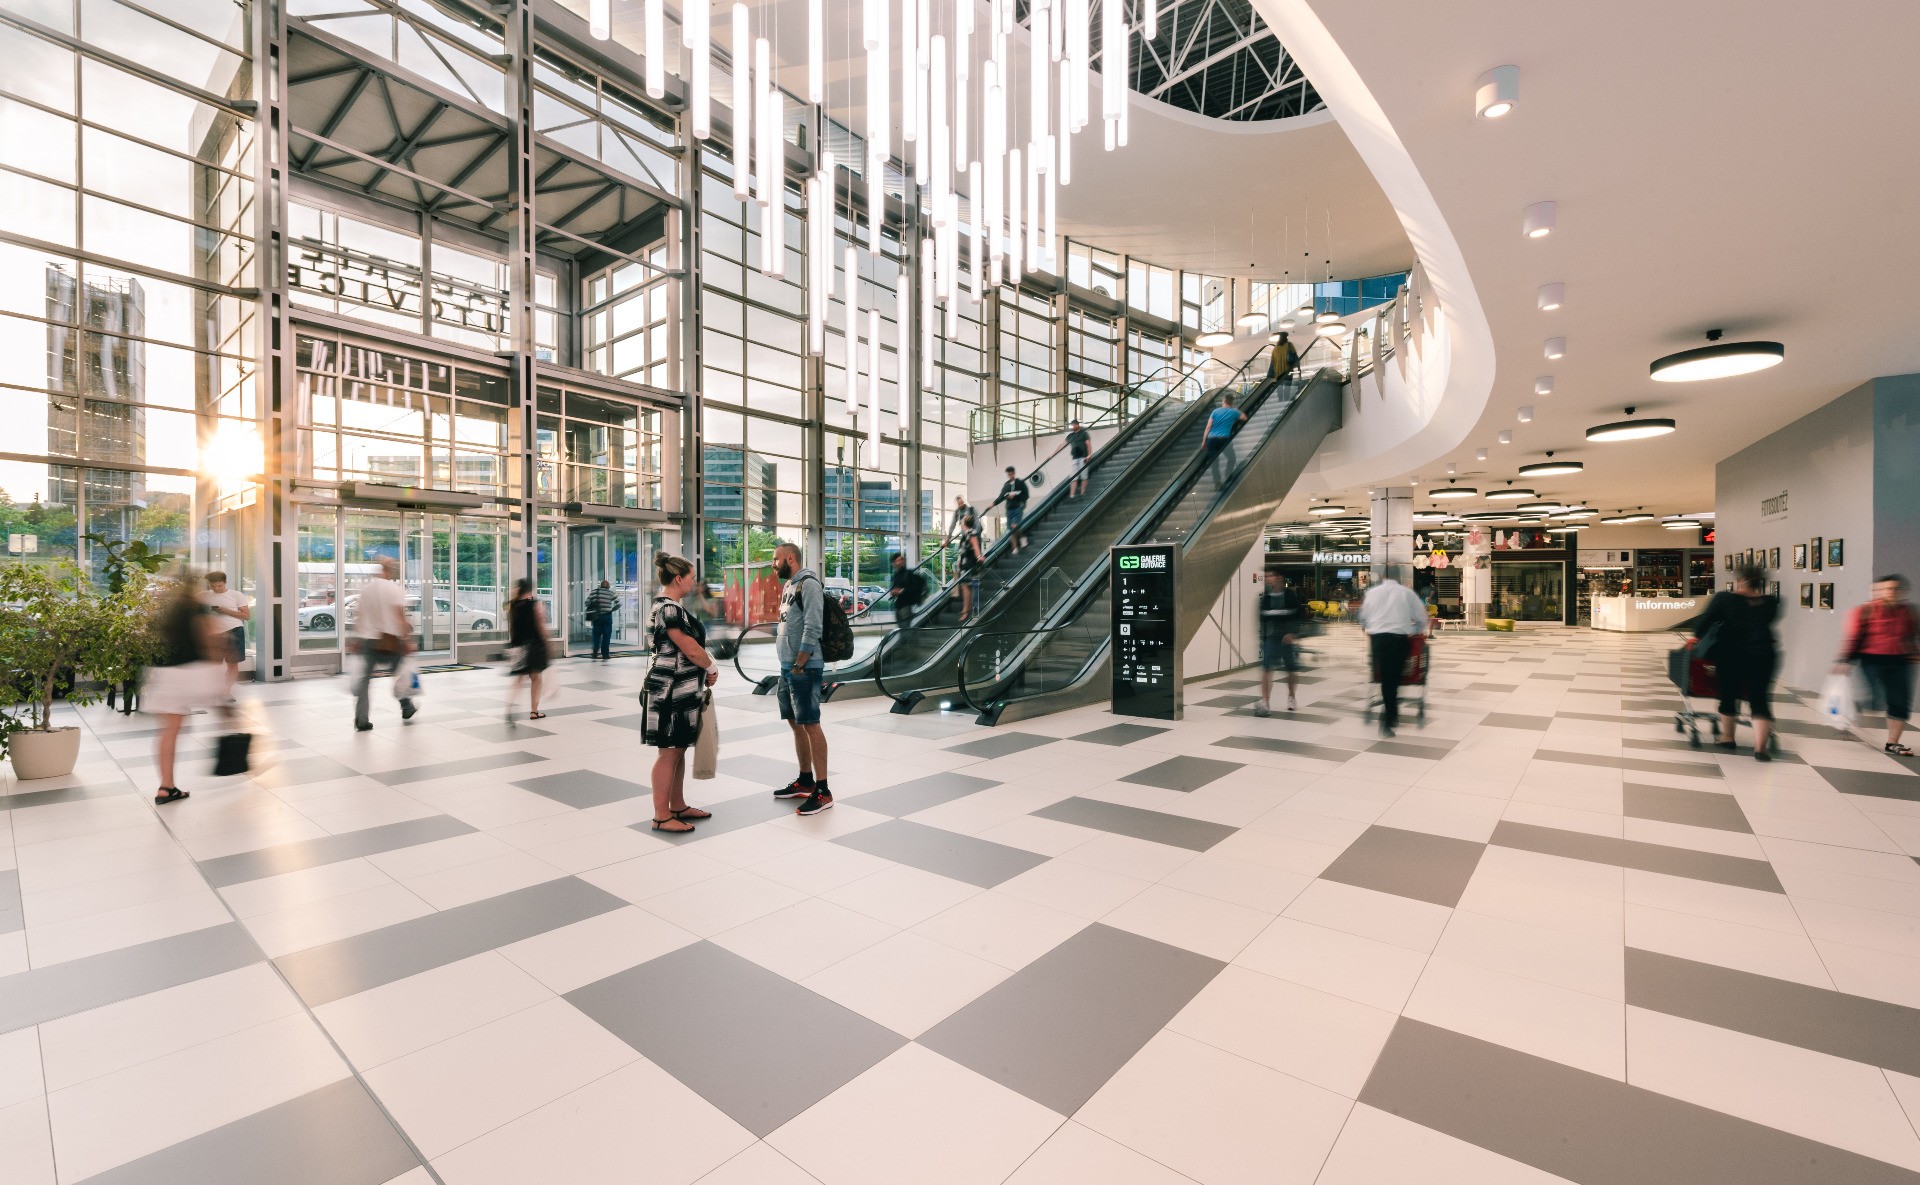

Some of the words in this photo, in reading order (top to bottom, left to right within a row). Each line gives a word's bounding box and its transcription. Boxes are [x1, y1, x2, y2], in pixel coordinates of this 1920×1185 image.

[1312, 552, 1371, 564] McDona
[1123, 578, 1127, 586] 1
[1635, 600, 1695, 610] informace
